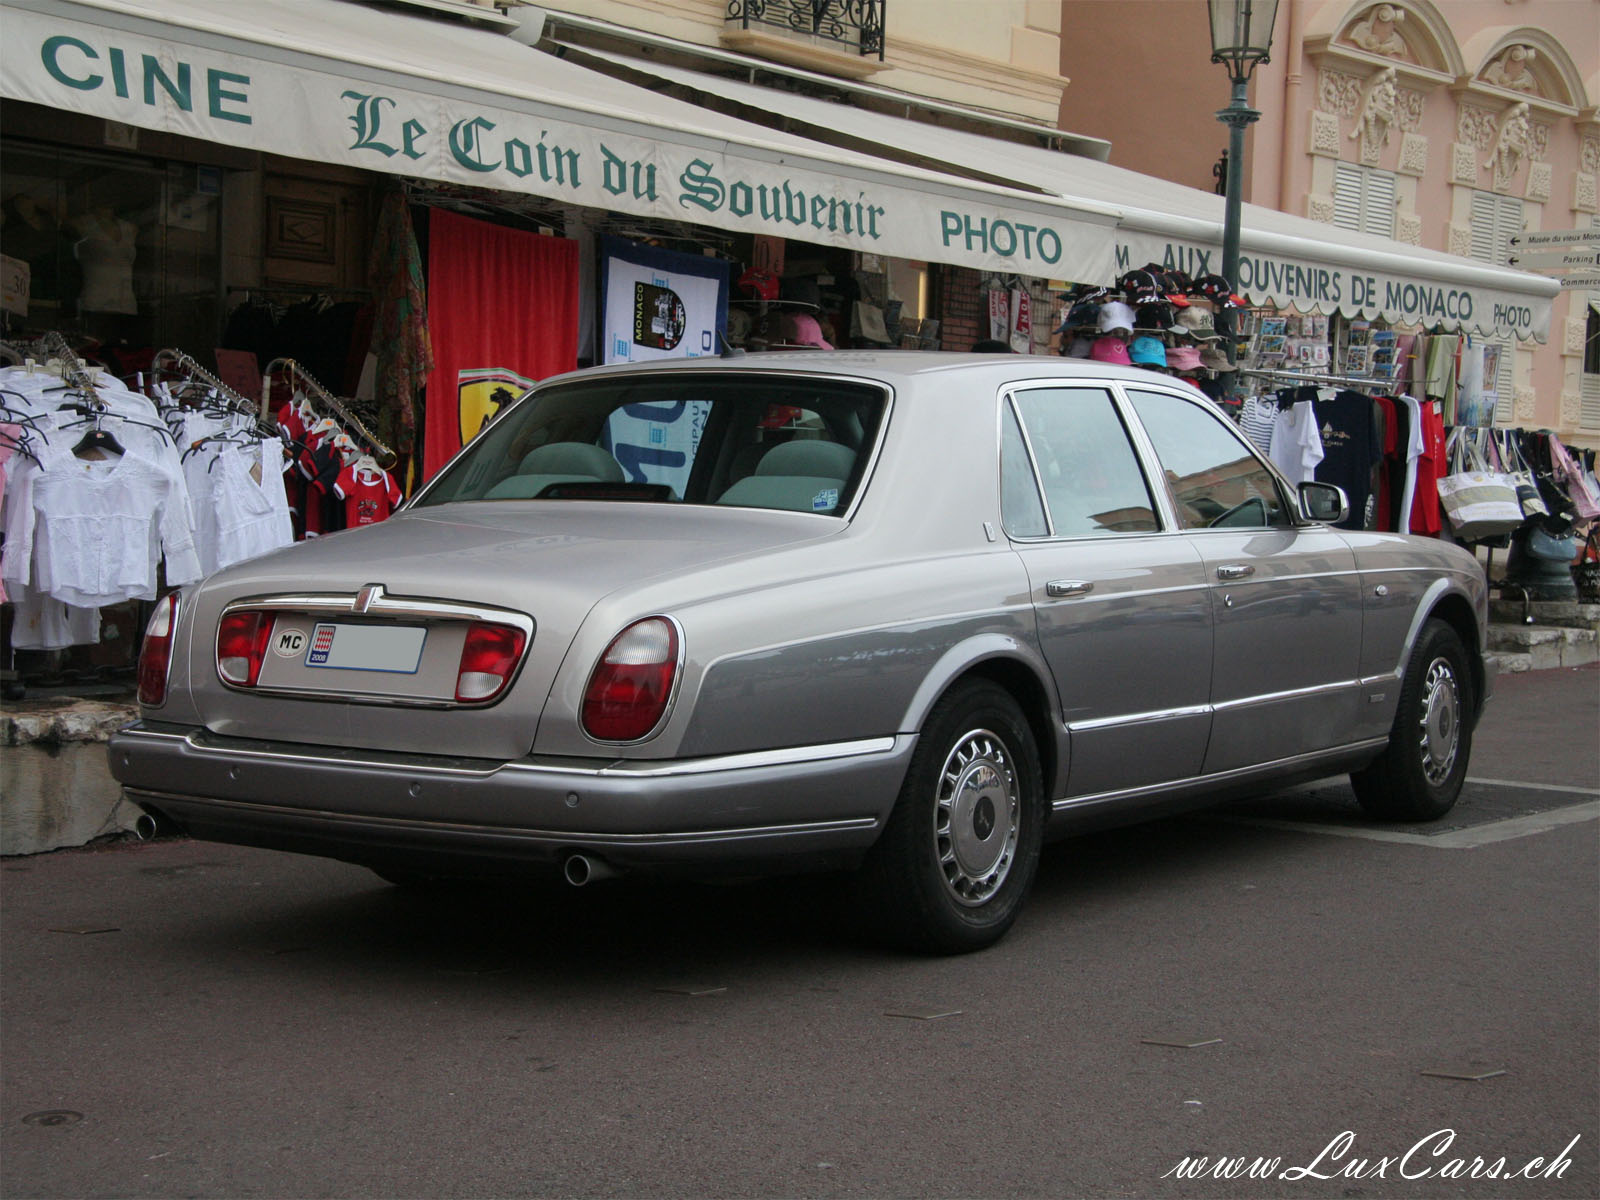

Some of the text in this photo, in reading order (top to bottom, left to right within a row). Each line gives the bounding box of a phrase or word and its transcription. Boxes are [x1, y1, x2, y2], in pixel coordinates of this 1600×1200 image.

[41, 35, 253, 125] CINE
[341, 90, 886, 241] Le Coin du Souvenir
[940, 210, 1063, 265] PHOTO
[1563, 255, 1593, 264] Parking
[635, 284, 645, 341] MONACO
[1162, 243, 1212, 280] AUX
[1238, 256, 1342, 303] OUVENIRS
[1351, 275, 1377, 308] DE
[1386, 281, 1474, 322] MONACO
[1494, 303, 1532, 329] PHOTO
[280, 635, 302, 649] MC
[312, 654, 326, 662] 2008
